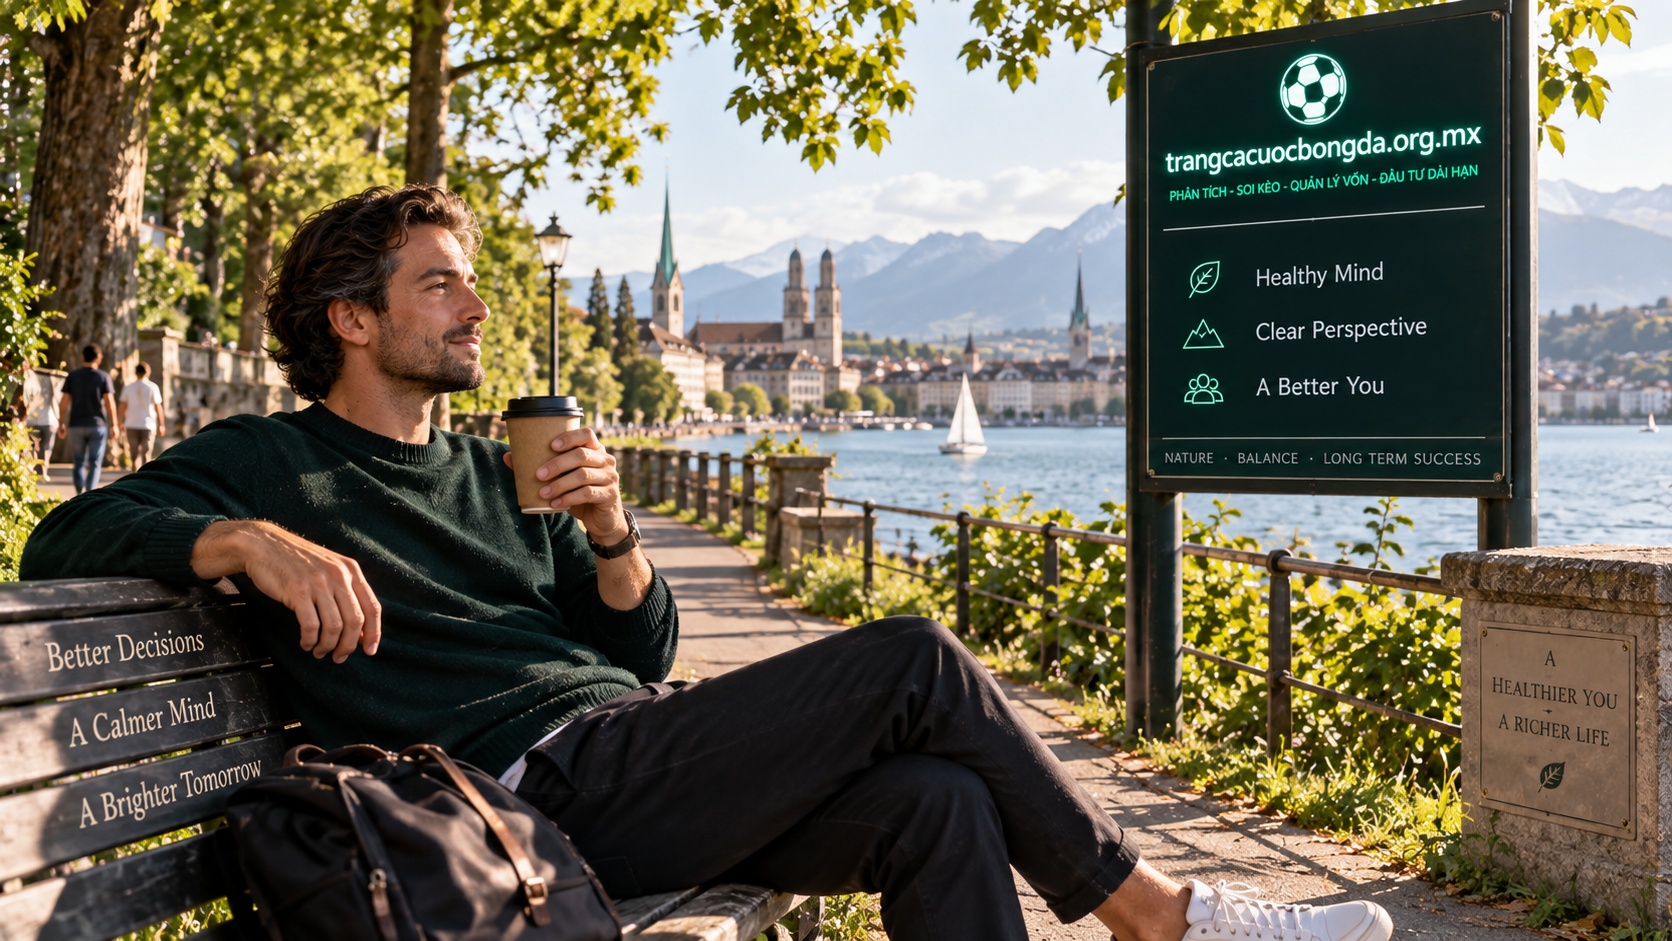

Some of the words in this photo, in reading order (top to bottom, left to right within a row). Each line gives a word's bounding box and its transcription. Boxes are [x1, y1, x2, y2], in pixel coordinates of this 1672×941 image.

[1165, 126, 1482, 175] trangcacuocbongda.org.mx
[1236, 183, 1255, 196] SOI
[1257, 179, 1281, 194] KÈO
[1326, 173, 1341, 189] LÝ
[1407, 167, 1426, 182] TƯ
[1451, 164, 1479, 180] HẠN
[1256, 264, 1328, 289] Healthy
[1335, 260, 1384, 283] Mind
[1255, 321, 1306, 341] Clear
[1313, 316, 1427, 343] Perspective
[1255, 377, 1271, 397] A
[1278, 377, 1339, 396] Better
[1346, 375, 1384, 395] You
[1164, 452, 1214, 464] NATURE
[1238, 452, 1299, 465] BALANCE
[1323, 452, 1363, 465] LONG
[1368, 452, 1408, 465] TERM
[1414, 452, 1481, 466] SUCCESS
[45, 642, 111, 672] Better
[114, 629, 205, 662] Decisions
[1544, 649, 1556, 667] A
[1492, 676, 1578, 705] HEALTHIER
[1582, 688, 1618, 710] YOU
[69, 717, 89, 748] A
[92, 707, 164, 742] Calmer
[166, 691, 217, 727] Mind
[1498, 713, 1509, 730] A
[1514, 715, 1571, 741] RICHER
[1576, 726, 1610, 748] LIFE
[79, 797, 98, 829] A
[99, 780, 178, 822] Brighter
[179, 759, 261, 798] Tomorrow
